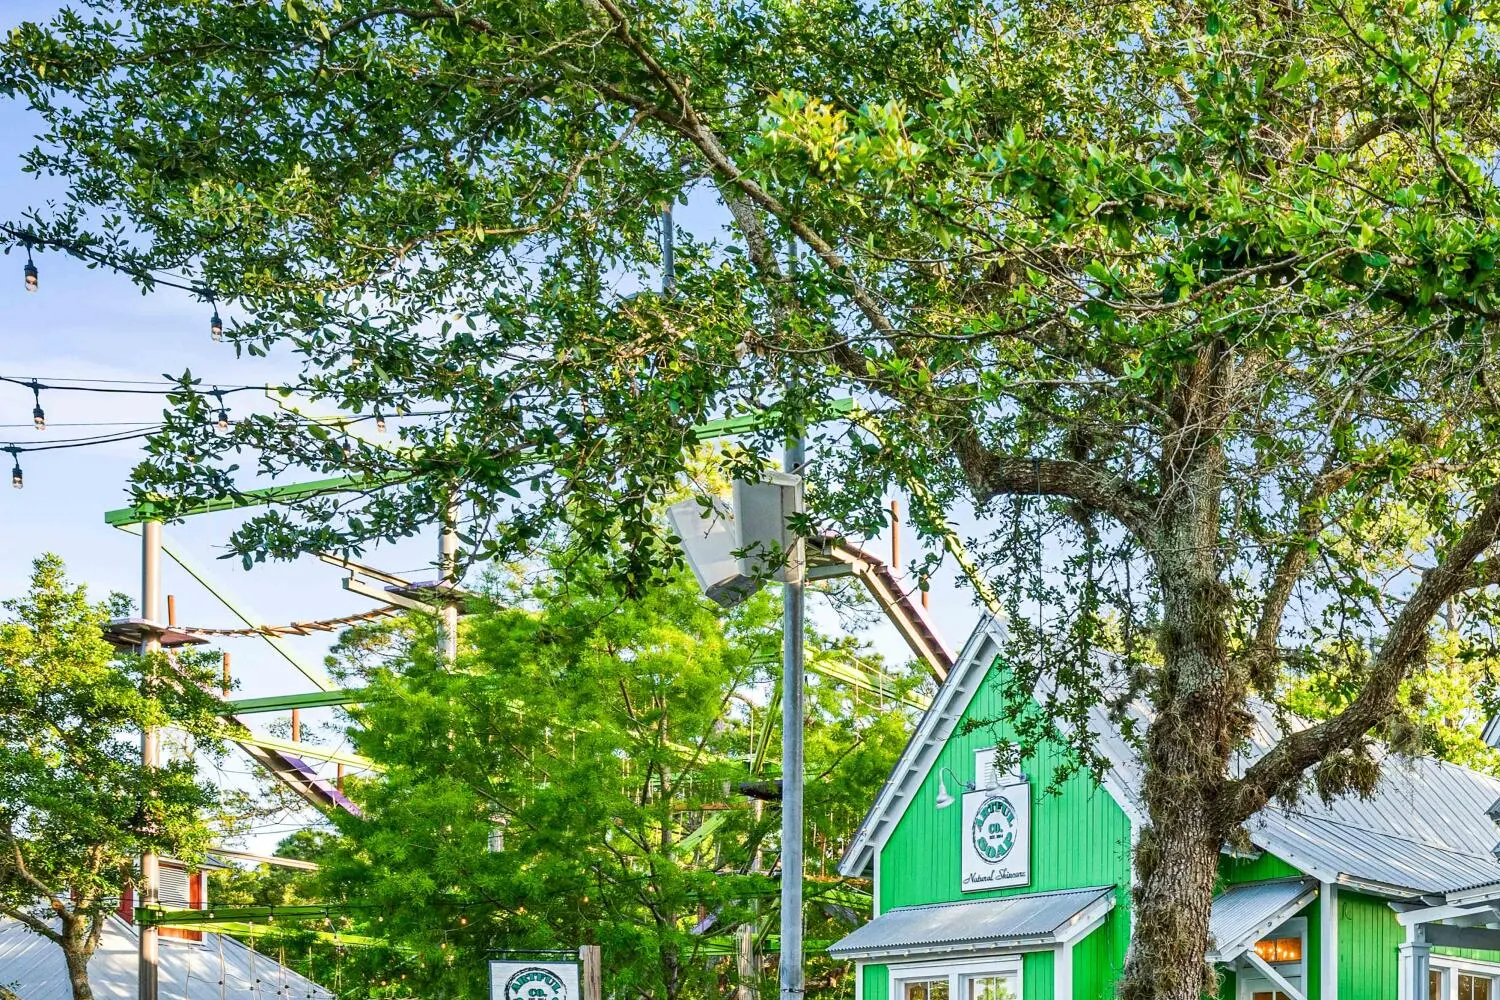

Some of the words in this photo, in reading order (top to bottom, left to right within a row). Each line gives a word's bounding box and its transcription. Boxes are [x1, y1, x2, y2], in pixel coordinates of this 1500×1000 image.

[976, 801, 1015, 832] ARTFUL
[988, 823, 1003, 834] CO.
[977, 832, 1013, 859] SOAP
[963, 869, 995, 885] Natural
[995, 868, 1026, 881] Skincare
[511, 972, 561, 995] ARTFUL
[528, 988, 548, 998] CO.
